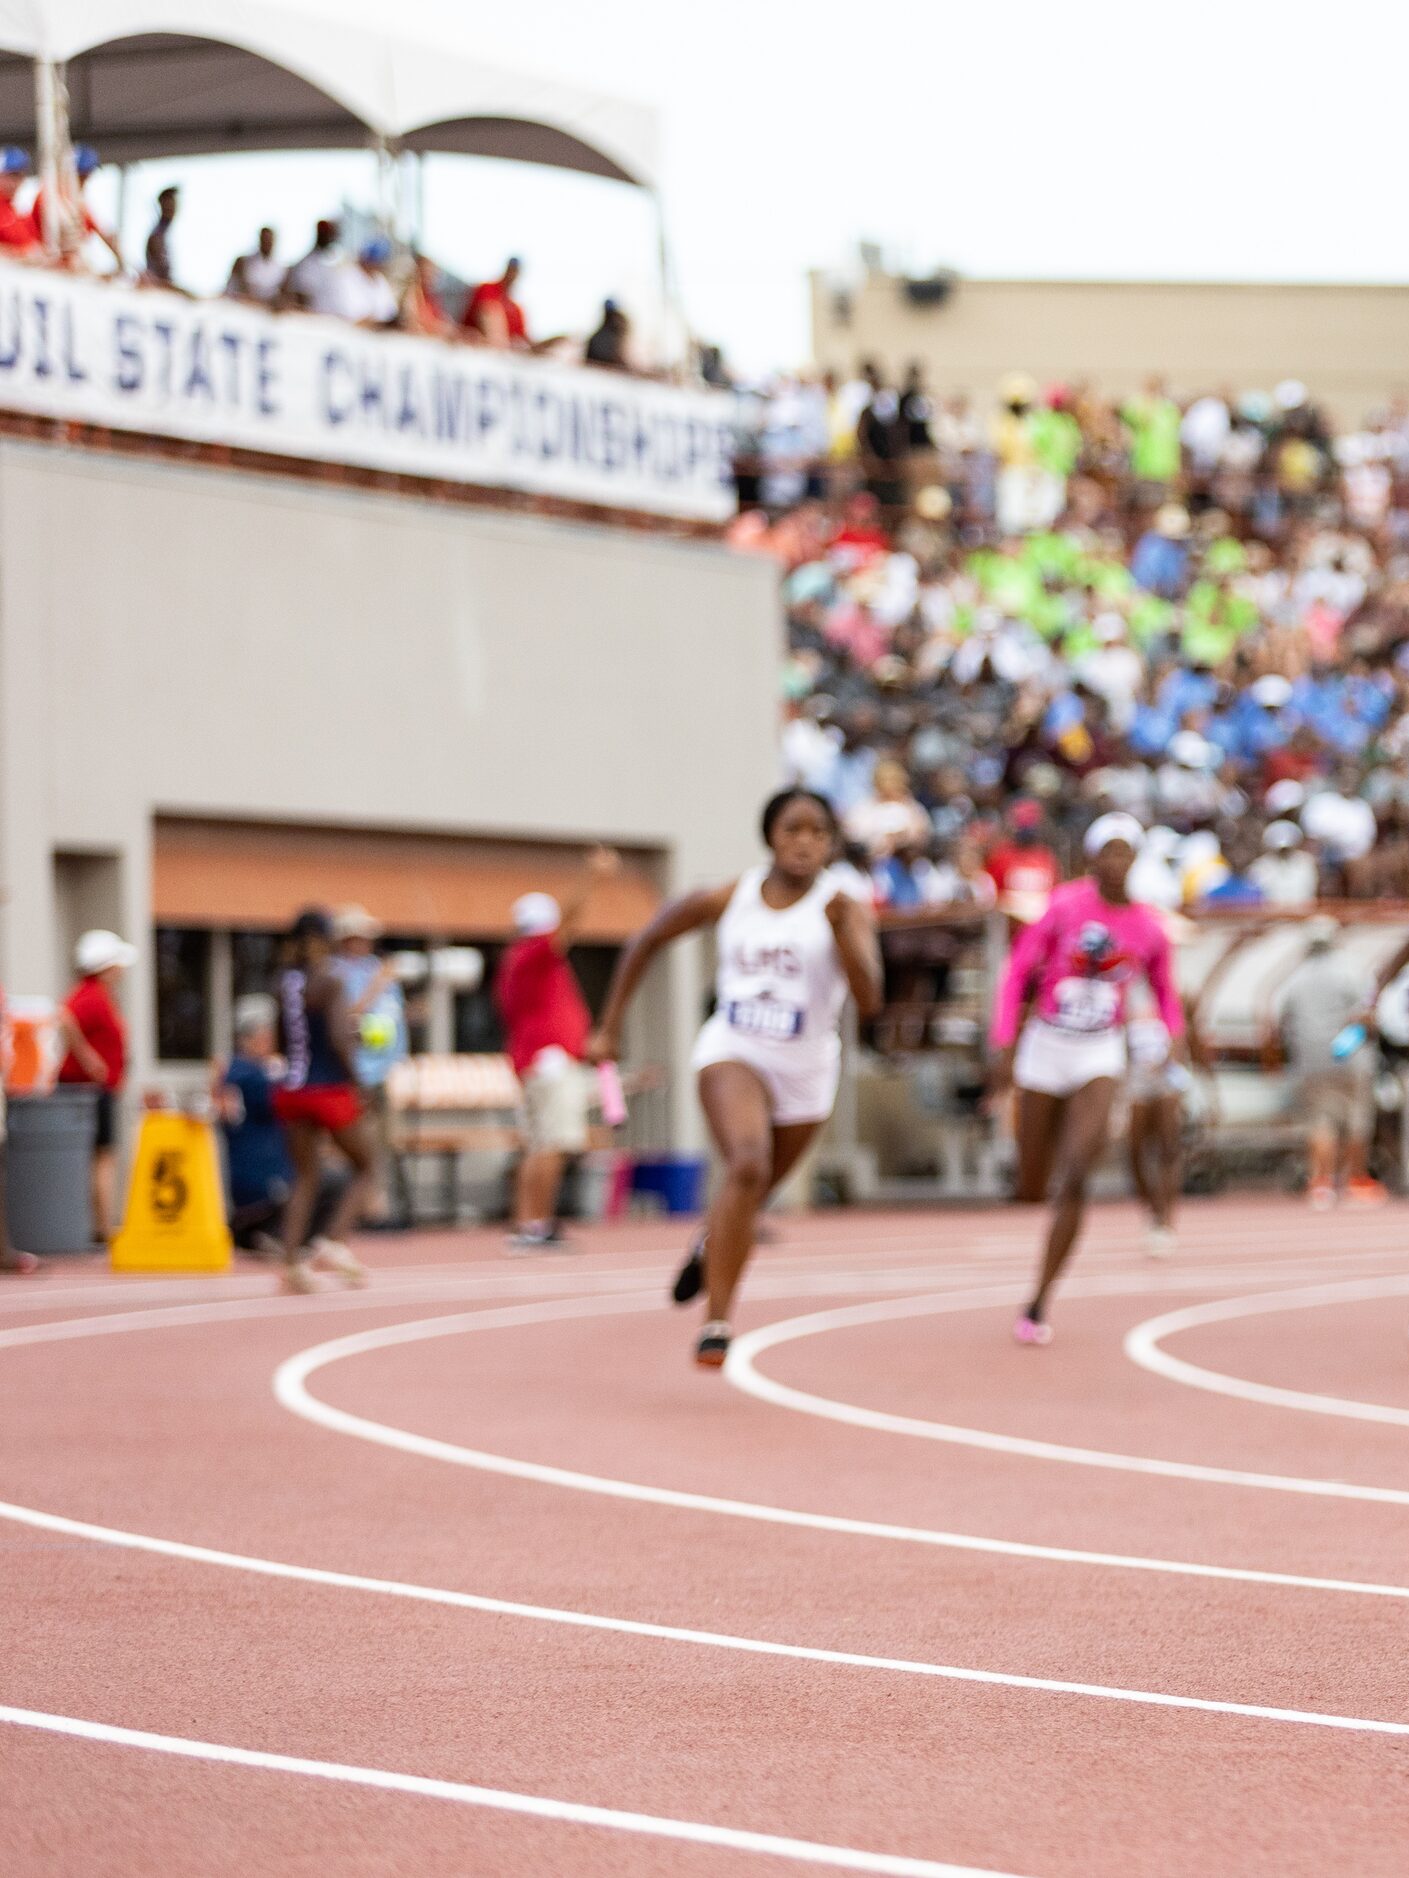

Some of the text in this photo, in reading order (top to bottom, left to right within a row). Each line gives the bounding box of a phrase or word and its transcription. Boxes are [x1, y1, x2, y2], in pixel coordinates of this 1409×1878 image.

[116, 312, 279, 416] STATE
[322, 348, 738, 490] CHAMPIONSHIPS
[153, 1150, 189, 1225] 5
